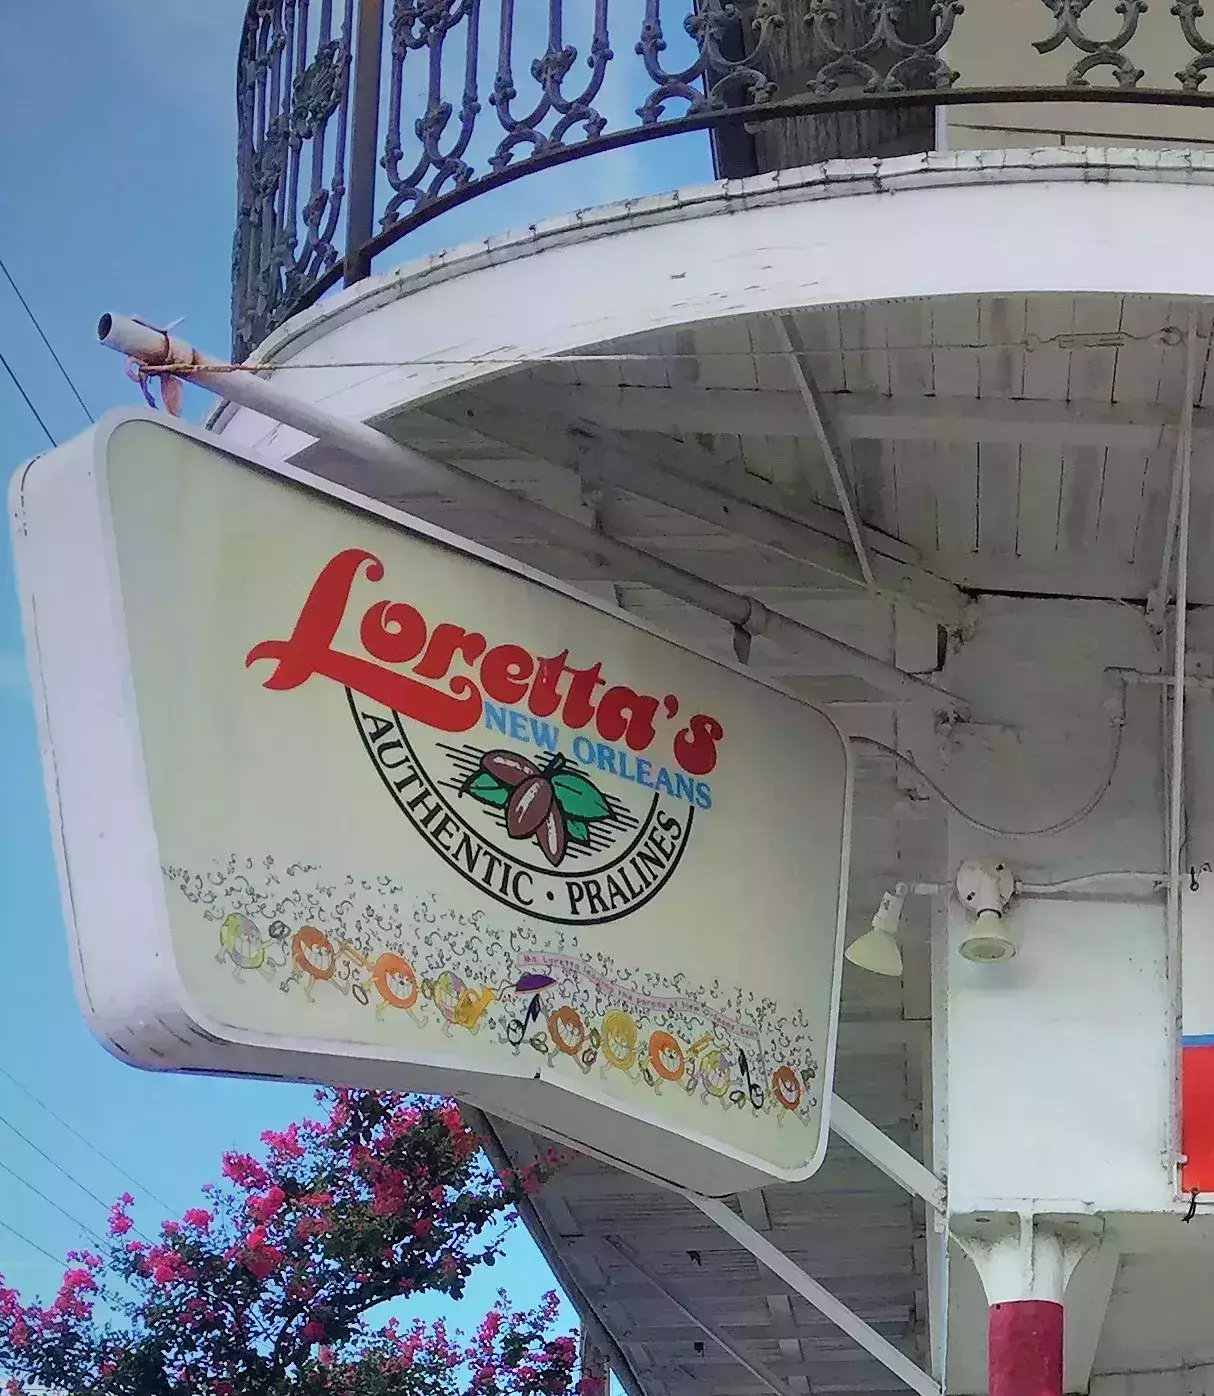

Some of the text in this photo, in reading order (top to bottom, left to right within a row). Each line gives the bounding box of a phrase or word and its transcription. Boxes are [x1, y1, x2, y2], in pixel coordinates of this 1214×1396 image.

[245, 547, 724, 775] Loretta's
[484, 701, 713, 810] NEW ORLEANS
[361, 711, 683, 915] AUTHENTIC PRALINES
